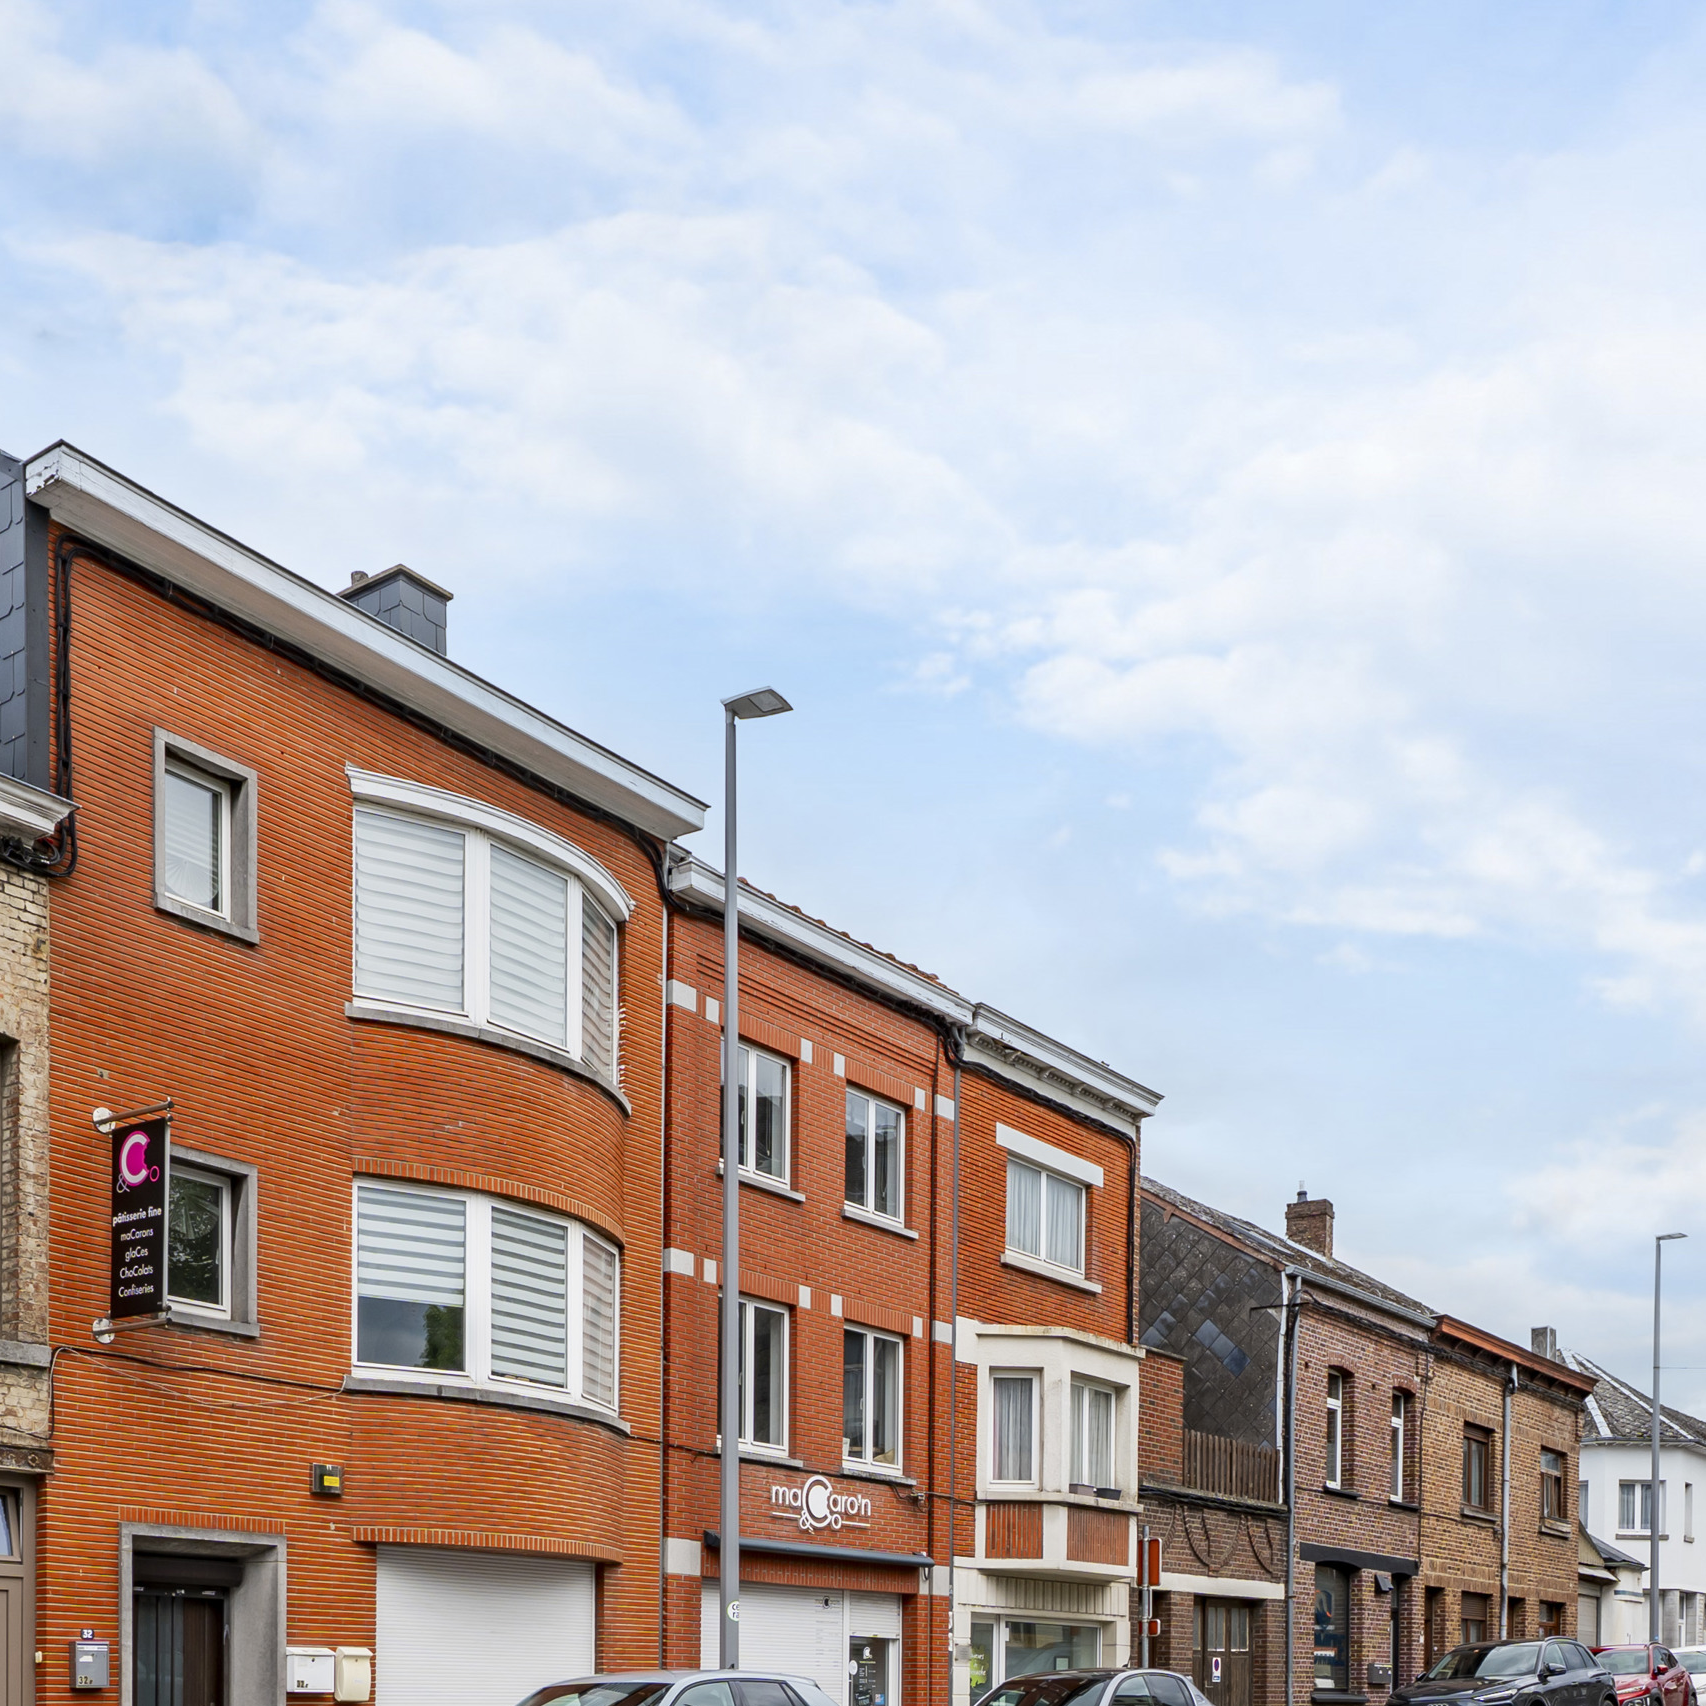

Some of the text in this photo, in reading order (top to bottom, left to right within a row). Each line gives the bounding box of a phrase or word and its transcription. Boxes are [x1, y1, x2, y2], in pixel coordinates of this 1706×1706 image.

[112, 1206, 162, 1227] pâtisserie fine
[118, 1283, 155, 1298] Confiseries
[82, 1629, 93, 1639] 32
